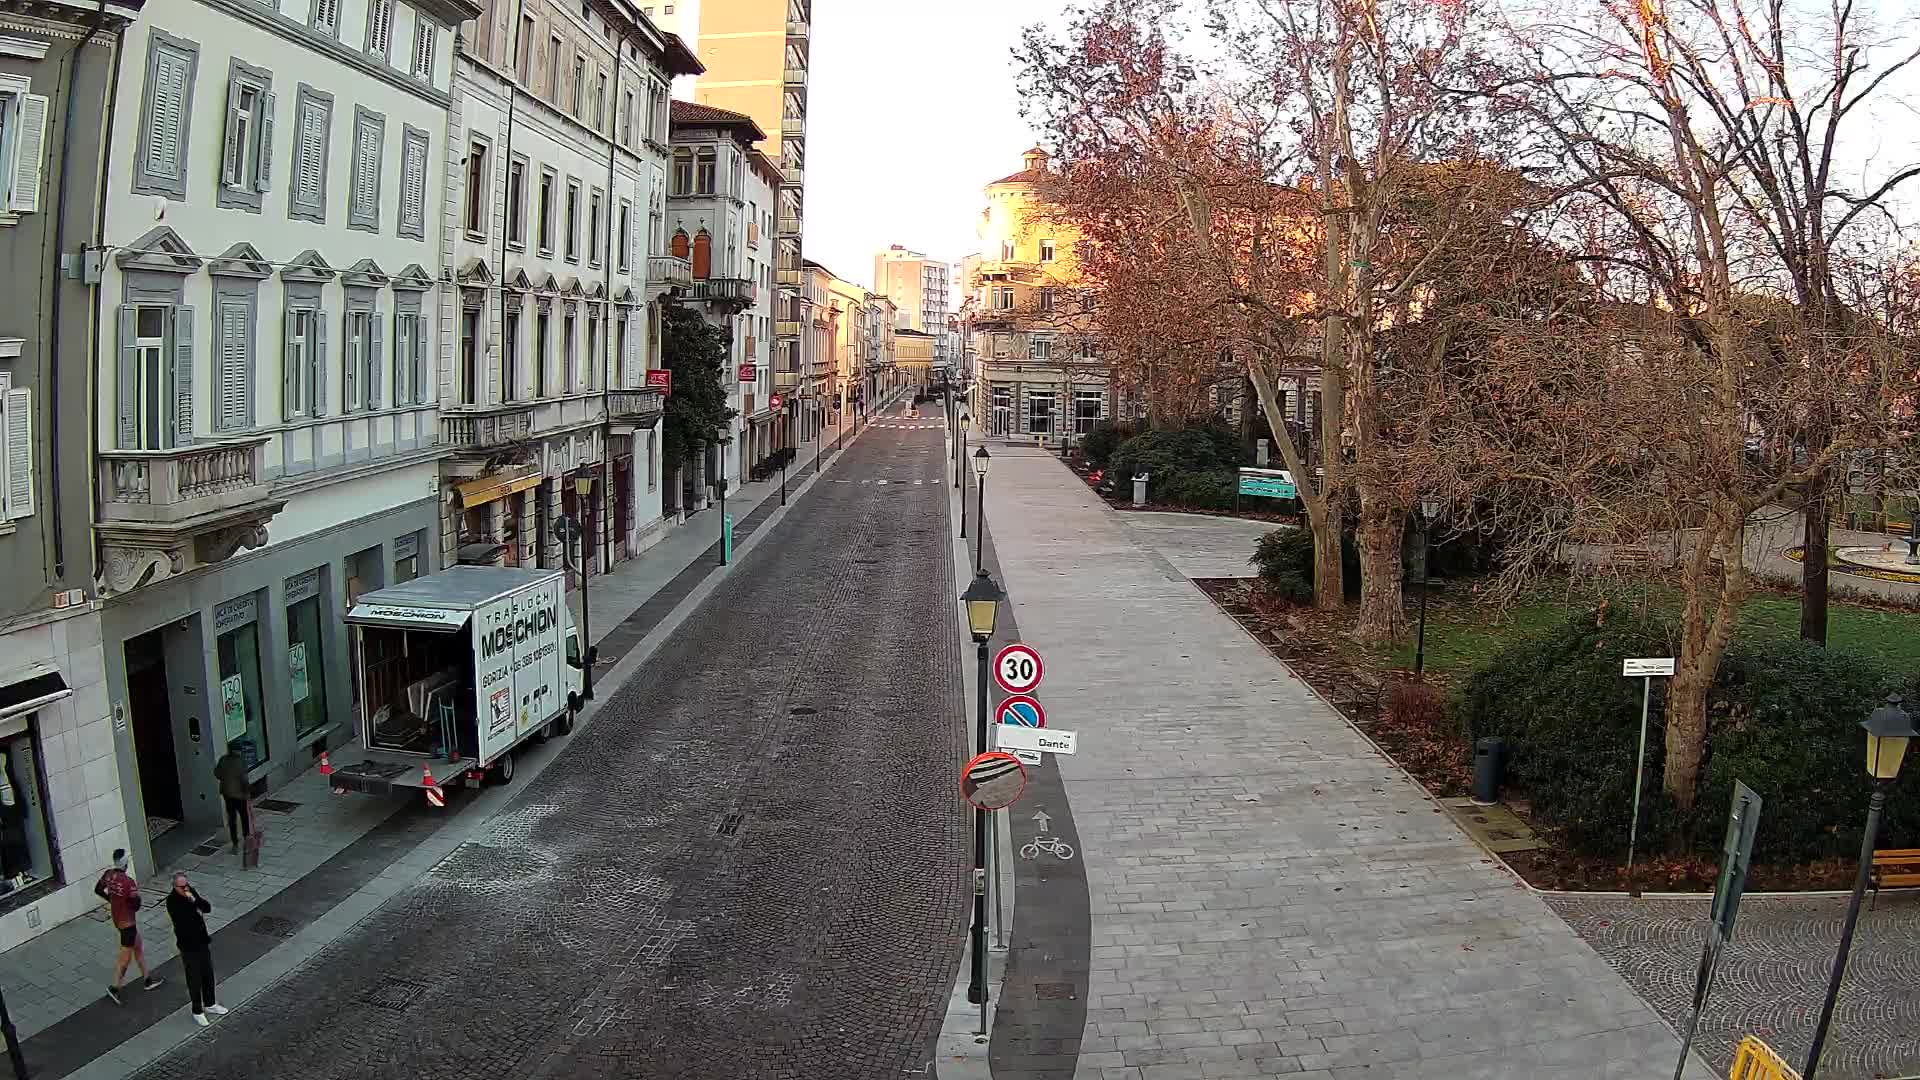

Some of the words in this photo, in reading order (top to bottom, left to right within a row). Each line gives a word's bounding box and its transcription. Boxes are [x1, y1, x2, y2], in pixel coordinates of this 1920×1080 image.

[370, 610, 446, 620] MOSCHION
[481, 604, 557, 661] MOSCHION
[1006, 658, 1033, 680] 30
[1038, 738, 1069, 749] Dante
